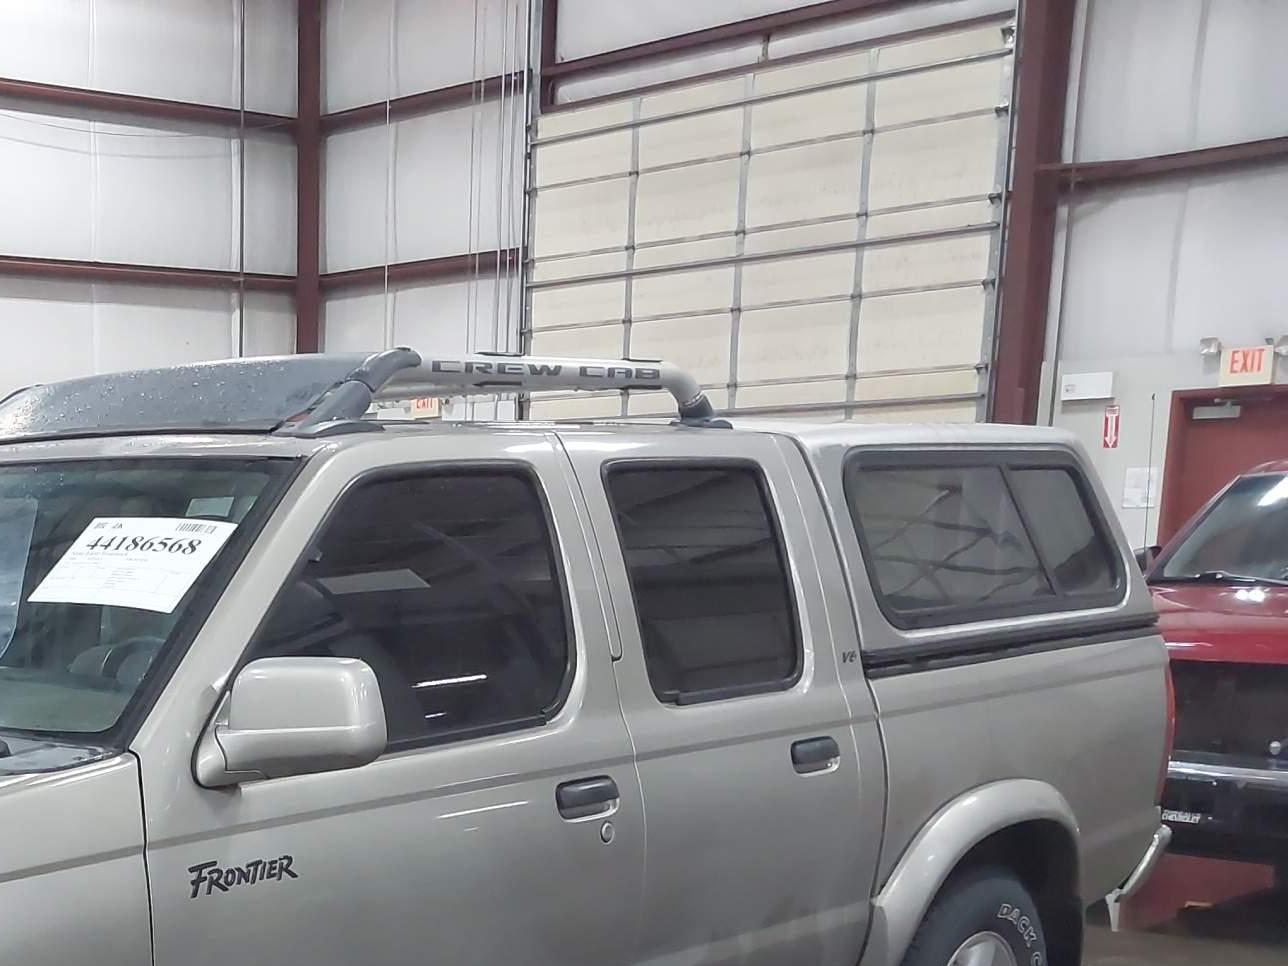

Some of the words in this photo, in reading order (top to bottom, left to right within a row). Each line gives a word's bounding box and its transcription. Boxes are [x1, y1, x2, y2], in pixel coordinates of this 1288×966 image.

[431, 360, 562, 377] CREW
[579, 366, 661, 380] CAB
[1229, 348, 1265, 374] EXIT
[86, 535, 202, 555] 44186568
